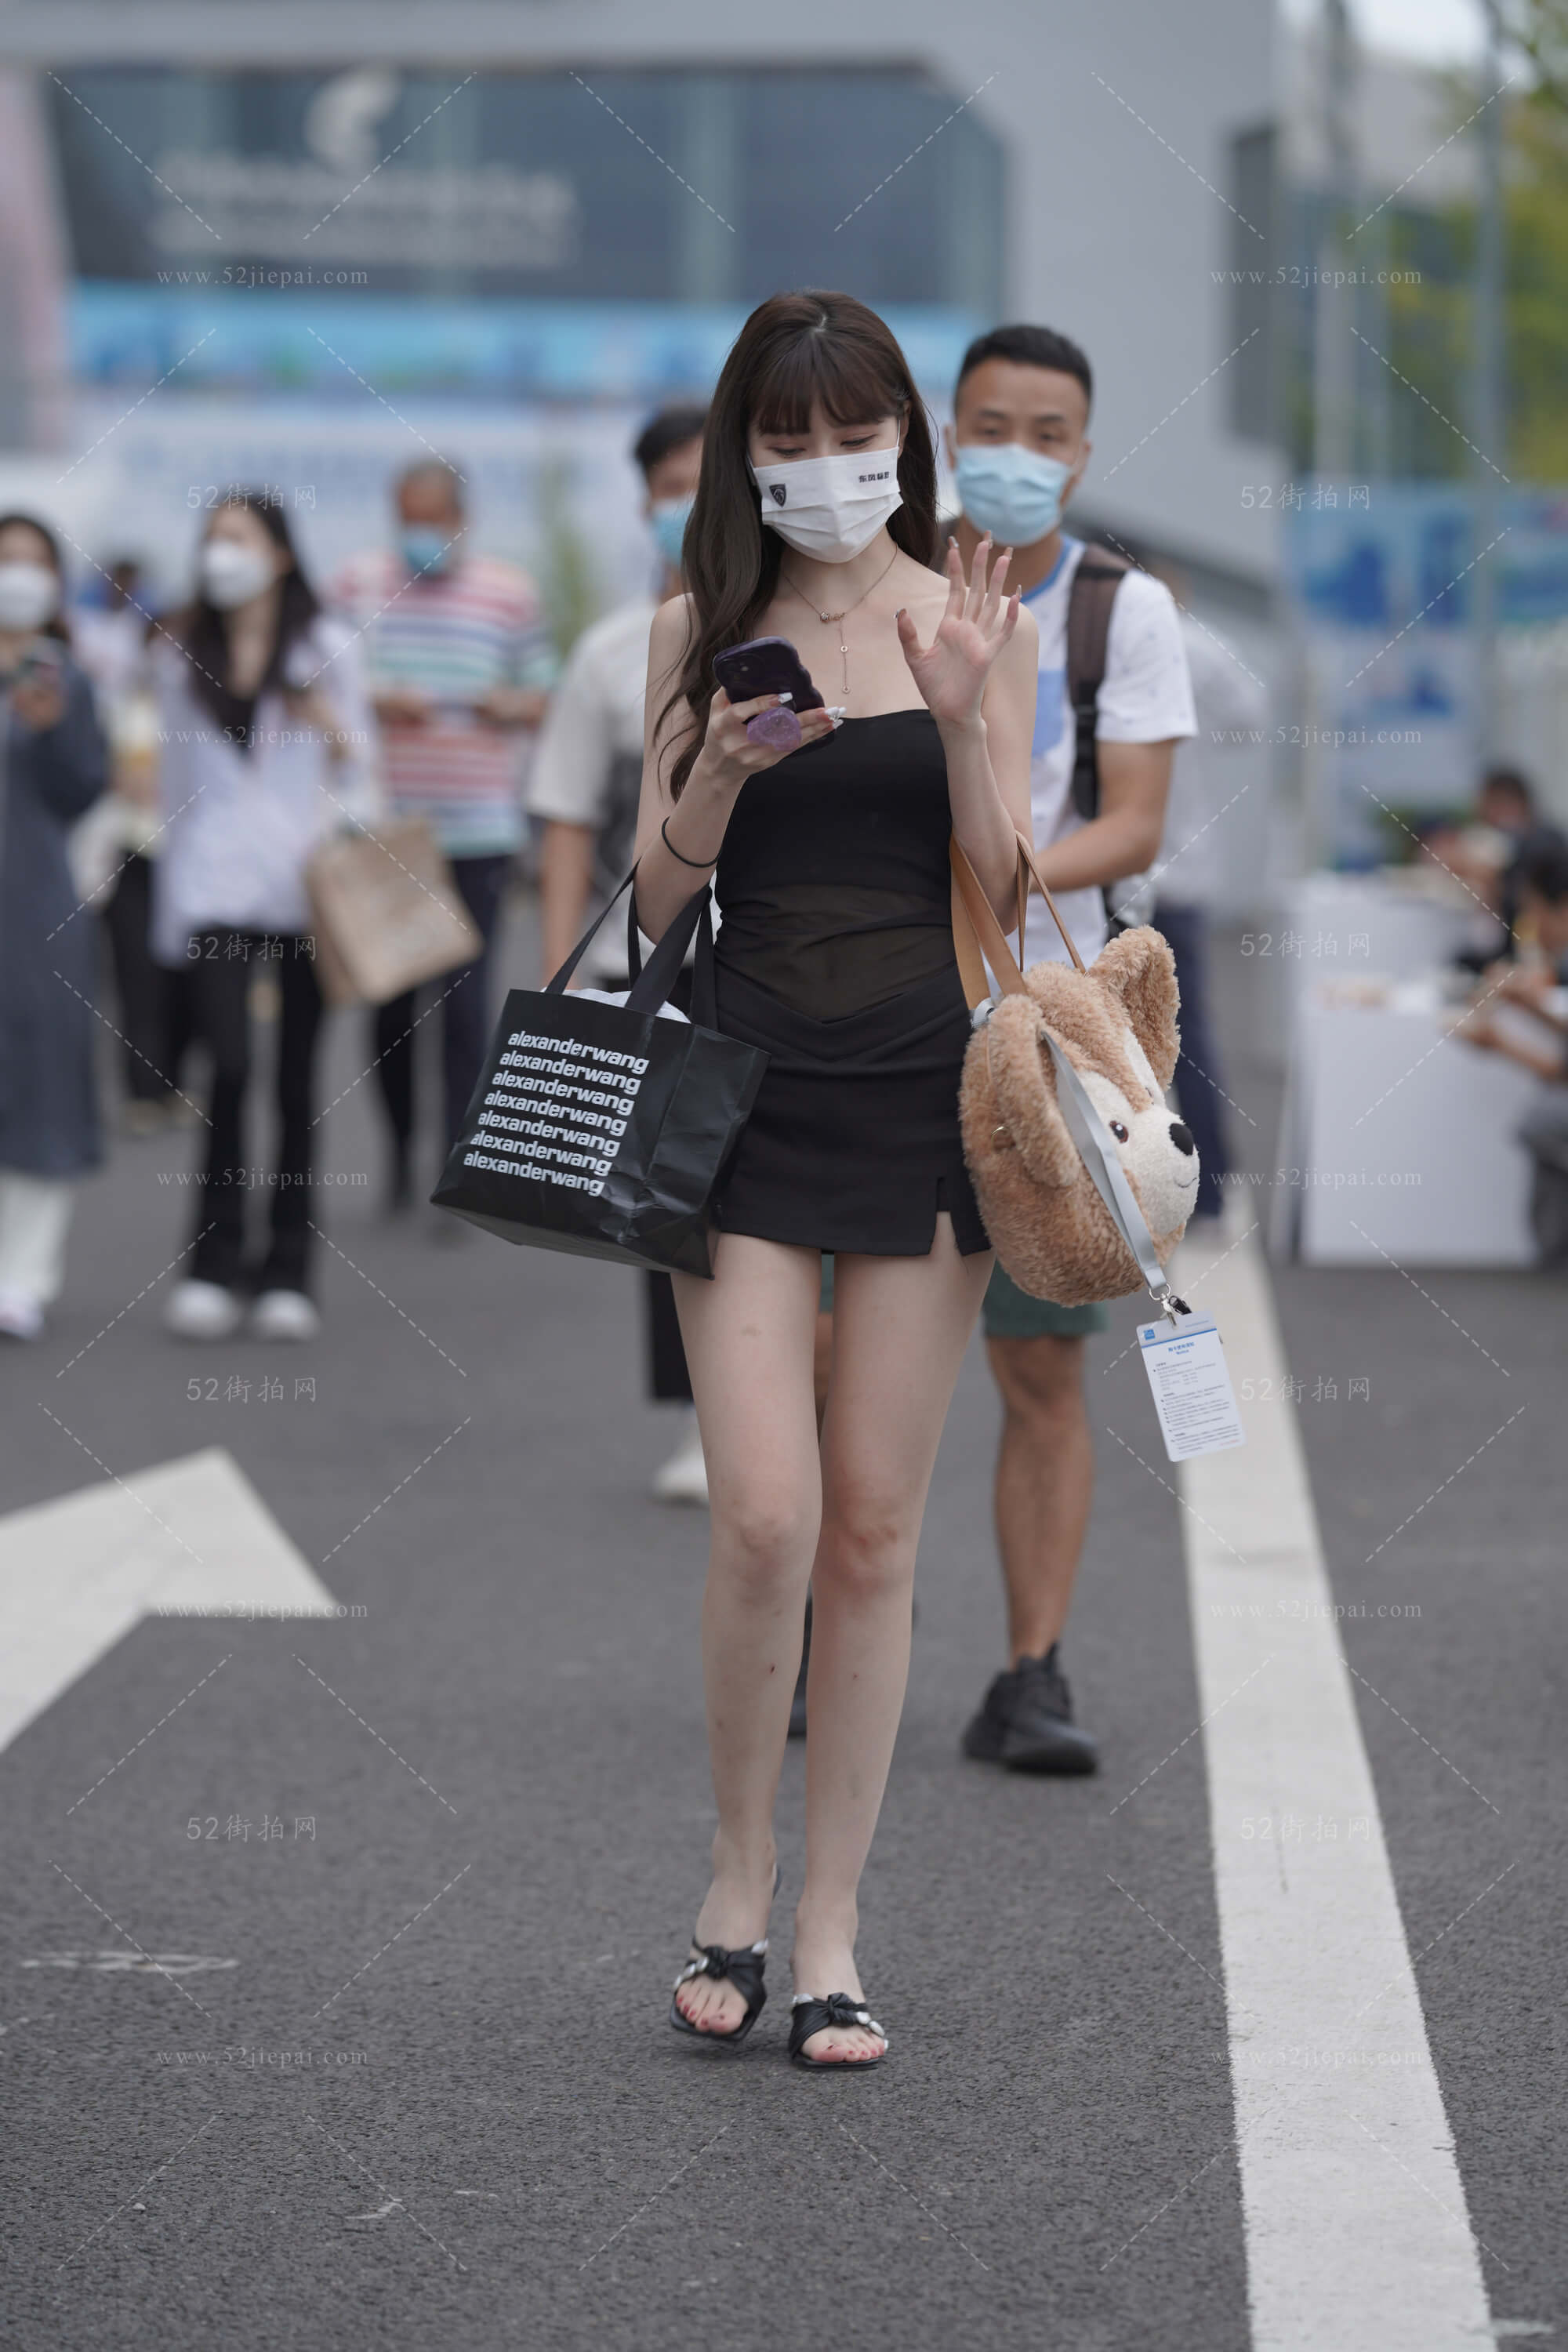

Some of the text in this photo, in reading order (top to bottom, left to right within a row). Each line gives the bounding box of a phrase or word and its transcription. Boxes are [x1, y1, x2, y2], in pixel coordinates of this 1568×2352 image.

[499, 1051, 641, 1095] alexanderwang
[508, 1031, 649, 1075] alexanderwang
[485, 1091, 627, 1137] alexanderwang
[492, 1071, 634, 1116] alexanderwang
[470, 1131, 612, 1177] alexanderwang
[477, 1110, 620, 1157] alexanderwang
[463, 1151, 605, 1196] alexanderwang
